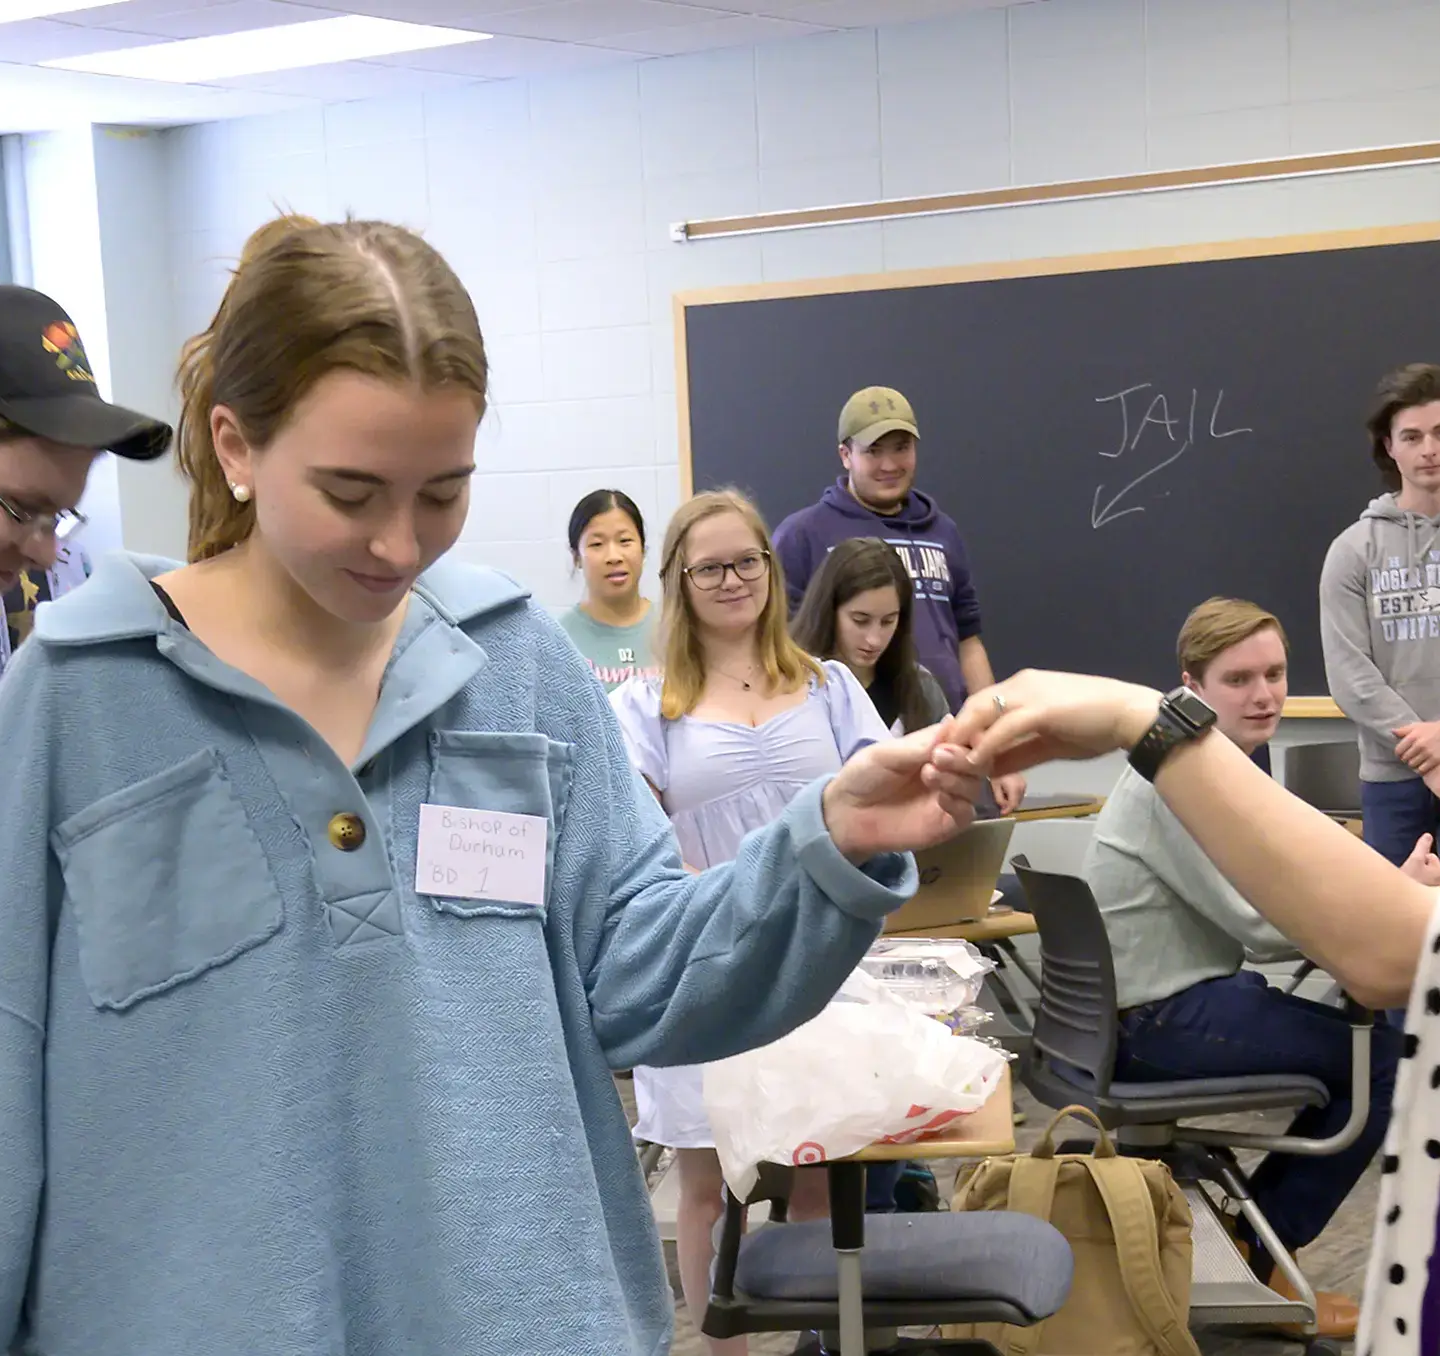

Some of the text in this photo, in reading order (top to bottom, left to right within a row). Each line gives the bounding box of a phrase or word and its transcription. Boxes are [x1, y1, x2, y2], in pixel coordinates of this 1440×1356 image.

[1095, 383, 1253, 458] JAIL
[895, 546, 951, 582] ILIAMS
[1379, 595, 1418, 615] EST.
[508, 820, 533, 838] of
[449, 833, 526, 860] Durham
[473, 866, 490, 894] 1
